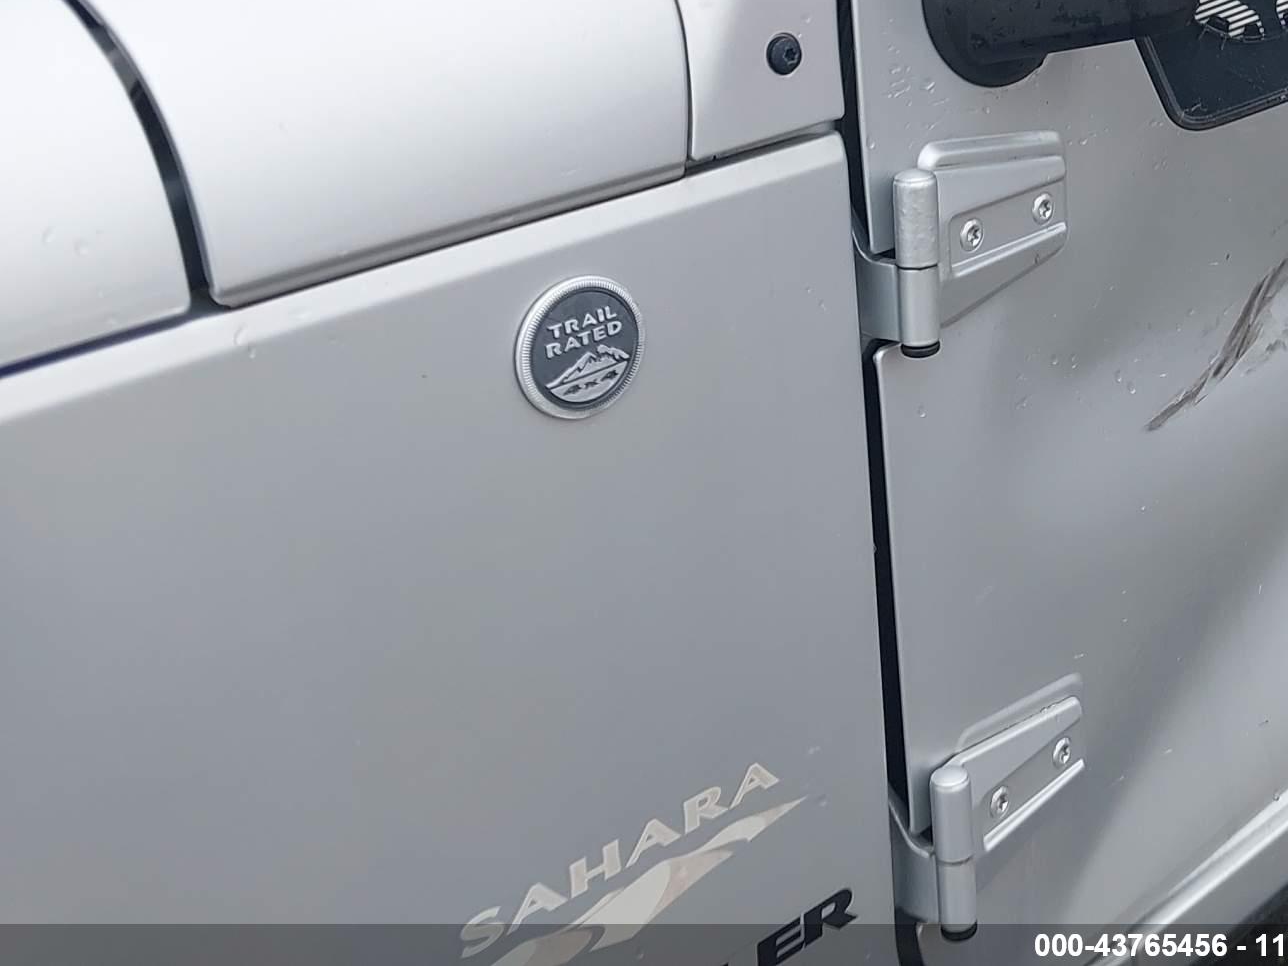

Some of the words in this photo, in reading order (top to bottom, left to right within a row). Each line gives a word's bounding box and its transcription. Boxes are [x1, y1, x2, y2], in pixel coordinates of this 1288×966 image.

[545, 321, 623, 359] RATED
[547, 305, 617, 339] TRAIL
[459, 762, 780, 960] SAHARA
[755, 888, 859, 966] ER
